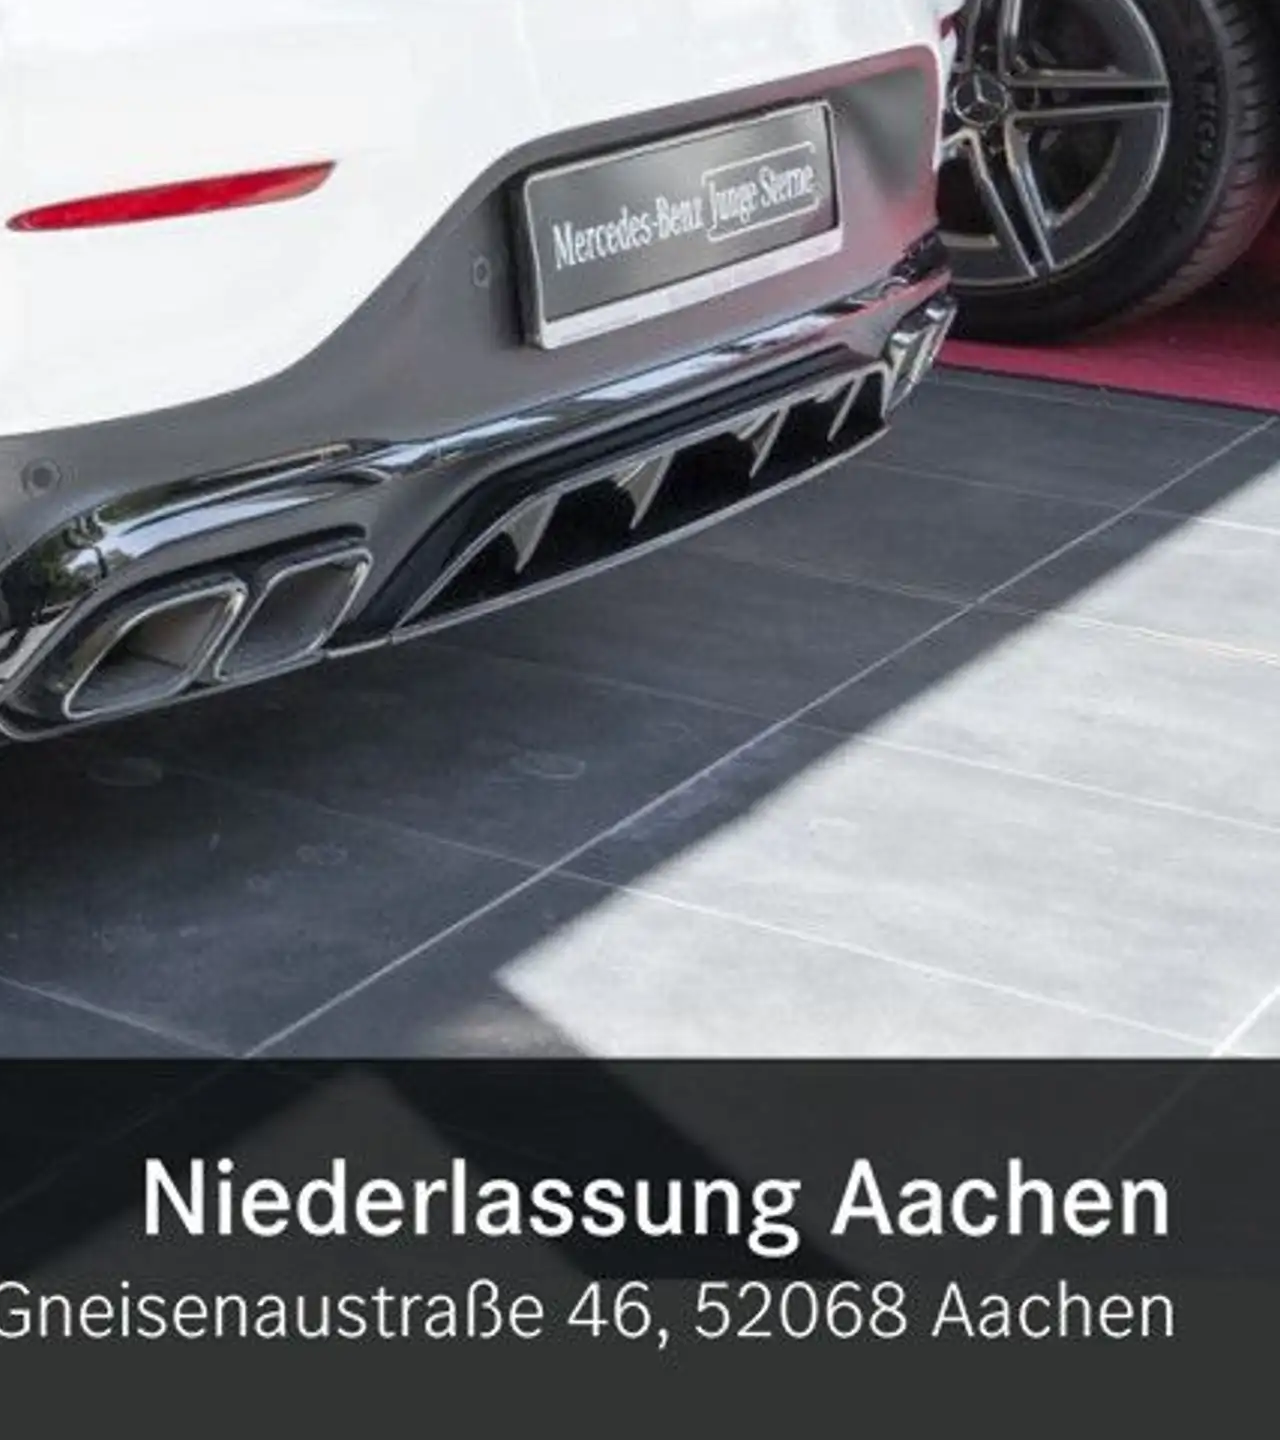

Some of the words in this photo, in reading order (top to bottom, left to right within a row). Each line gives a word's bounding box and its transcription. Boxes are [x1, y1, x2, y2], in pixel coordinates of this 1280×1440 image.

[552, 194, 704, 270] Mercedes-Benz
[709, 177, 759, 231] Junge
[758, 163, 815, 209] Sterne
